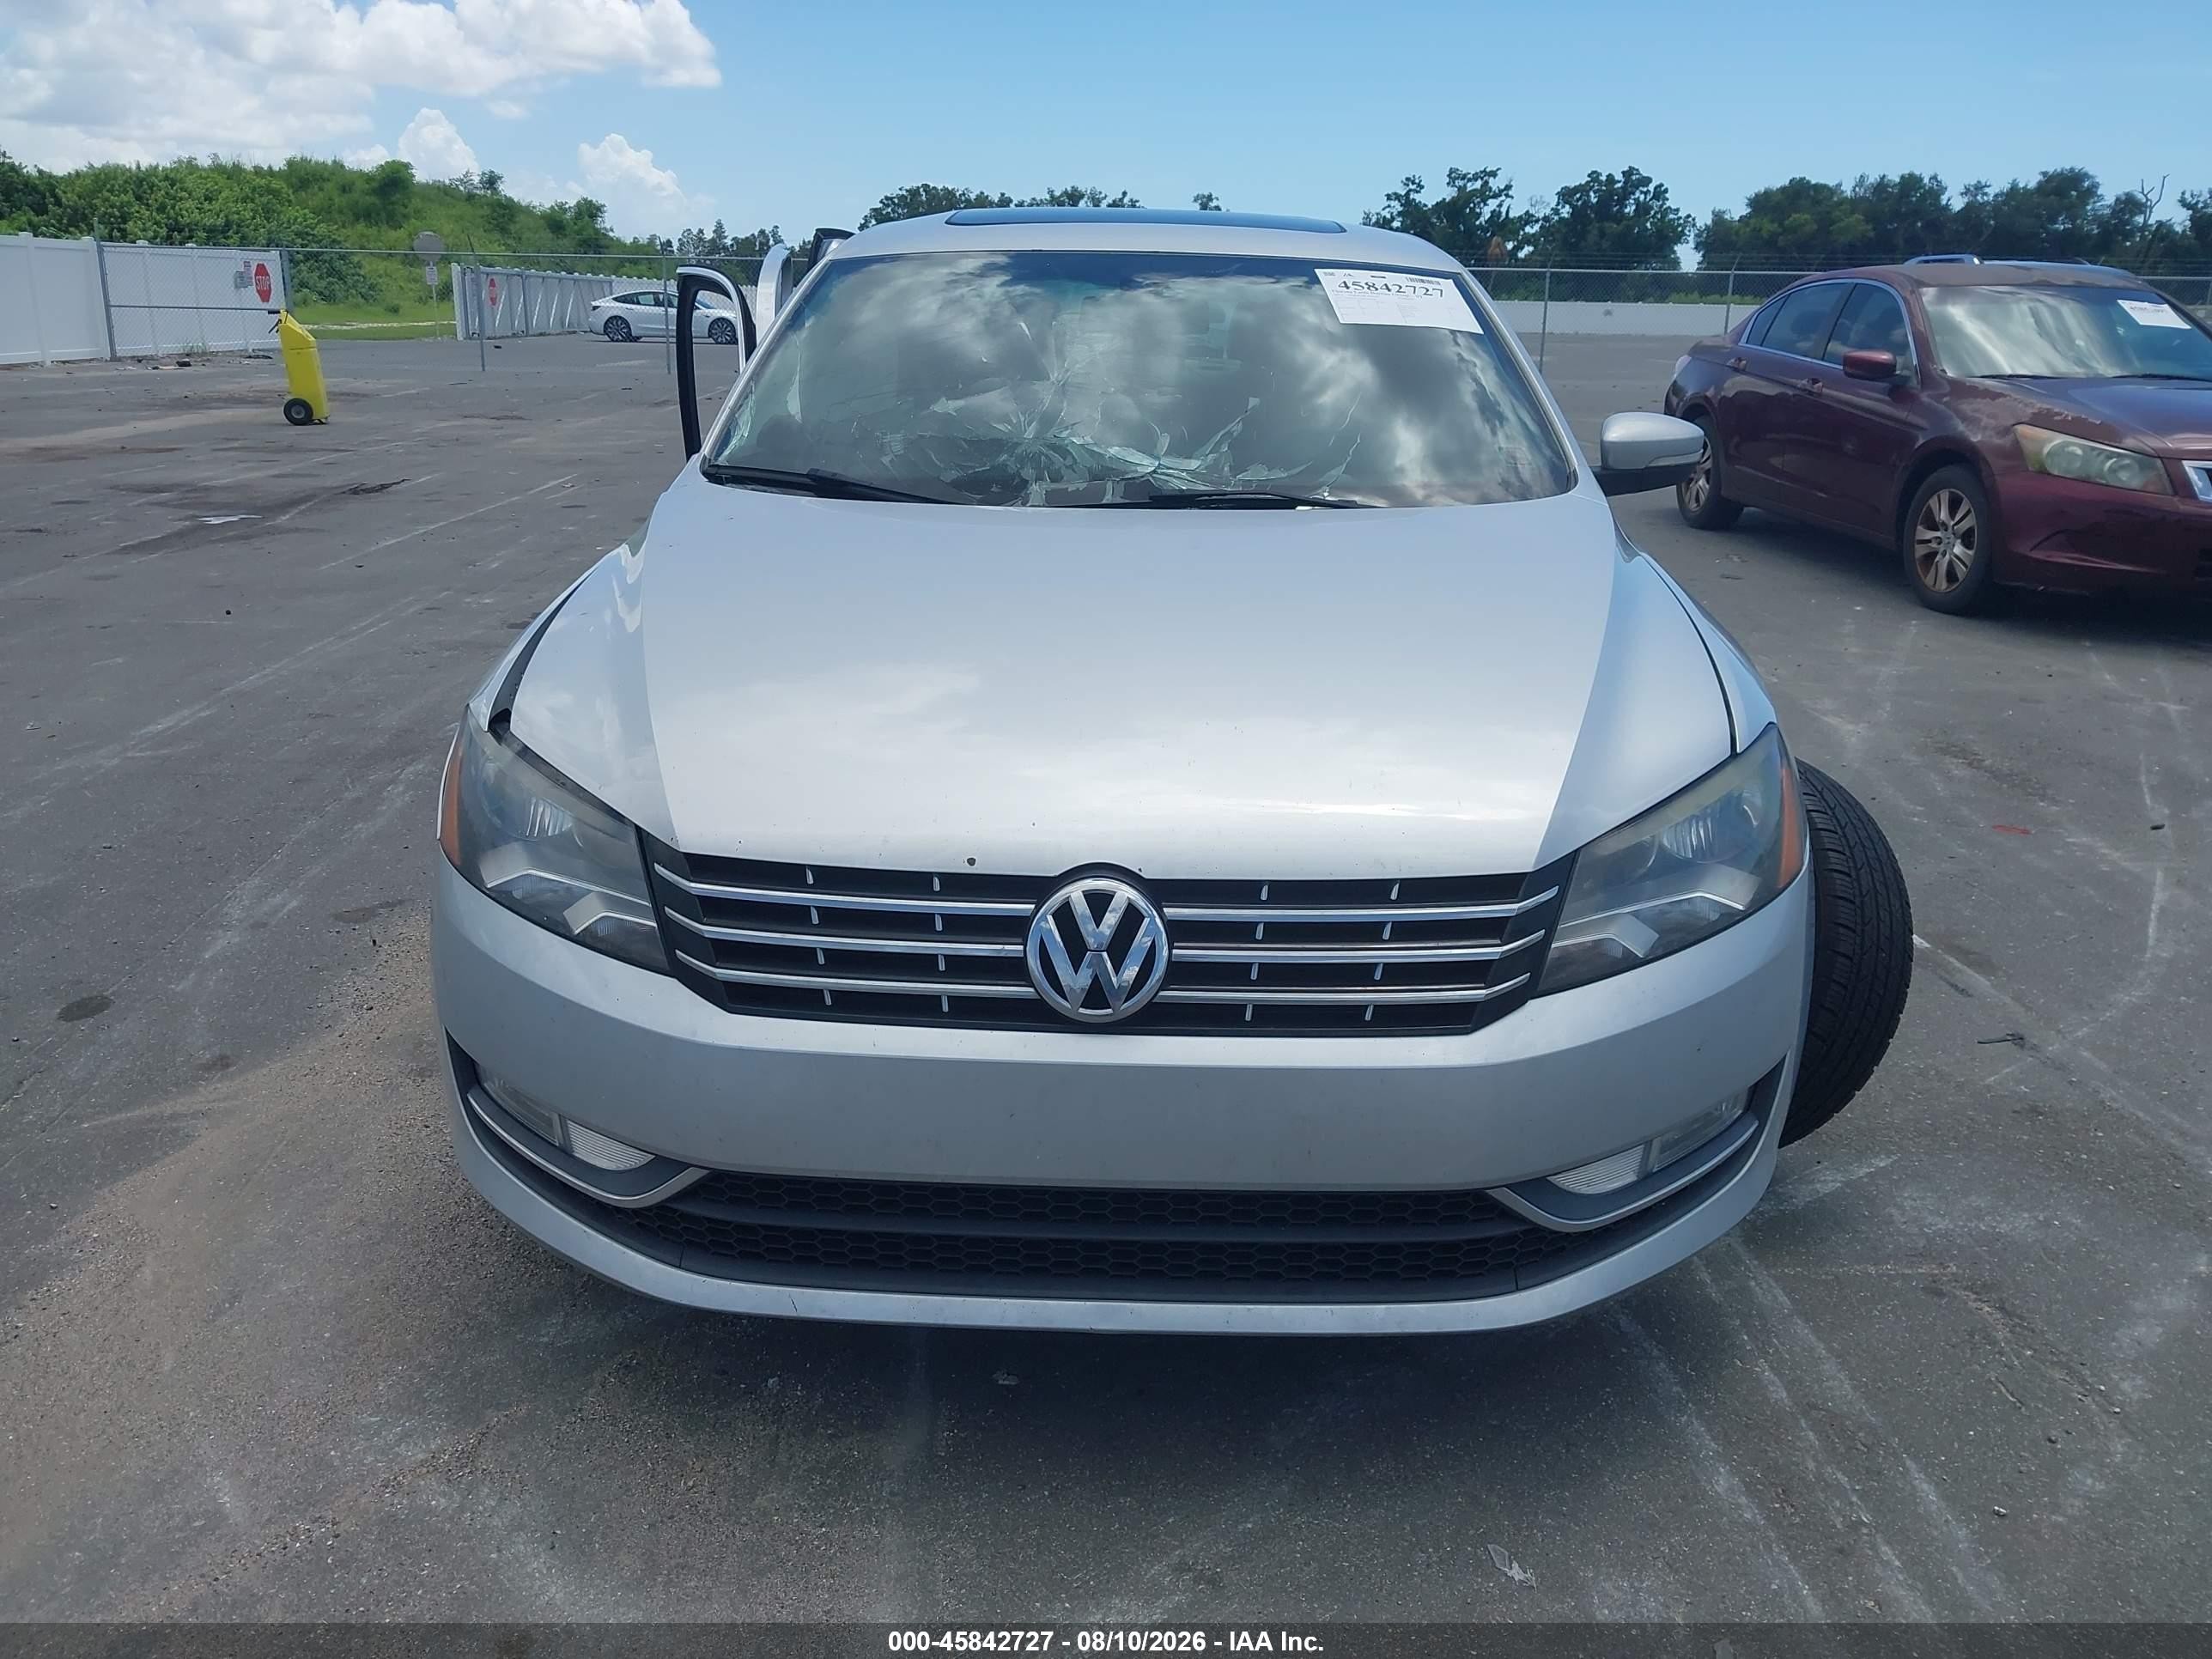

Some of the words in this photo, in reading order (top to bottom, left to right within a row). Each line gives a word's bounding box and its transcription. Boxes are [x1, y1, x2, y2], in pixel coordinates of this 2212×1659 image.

[256, 276, 270, 290] STOP
[1338, 280, 1443, 298] 45842727
[1035, 887, 1161, 1018] VW
